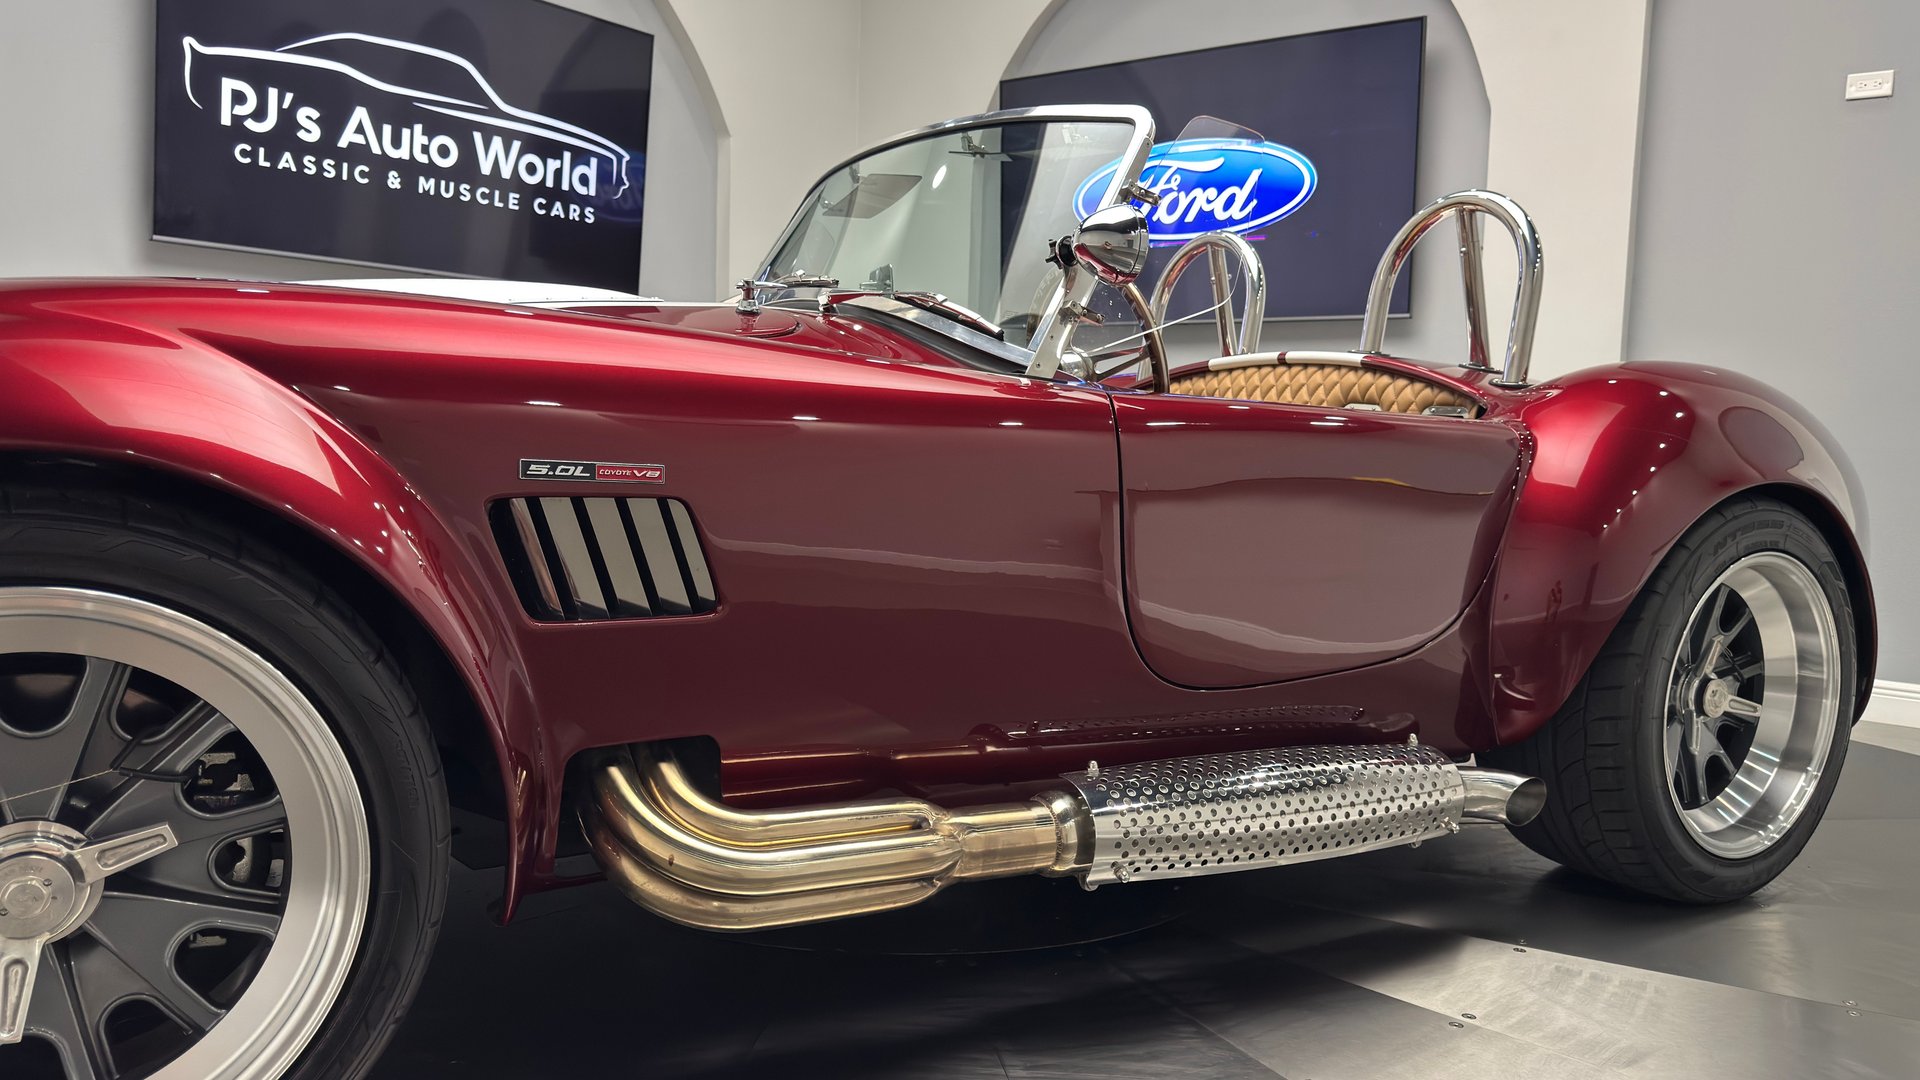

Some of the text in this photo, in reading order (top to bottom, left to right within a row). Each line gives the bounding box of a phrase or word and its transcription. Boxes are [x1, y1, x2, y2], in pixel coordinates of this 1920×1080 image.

[220, 76, 322, 143] PJ's
[337, 105, 459, 169] Auto
[472, 130, 598, 197] World
[233, 143, 596, 225] CLASSIC & MUSCLE CARS
[1138, 156, 1263, 225] Ford
[526, 463, 591, 477] 5.0L
[632, 469, 661, 478] V8
